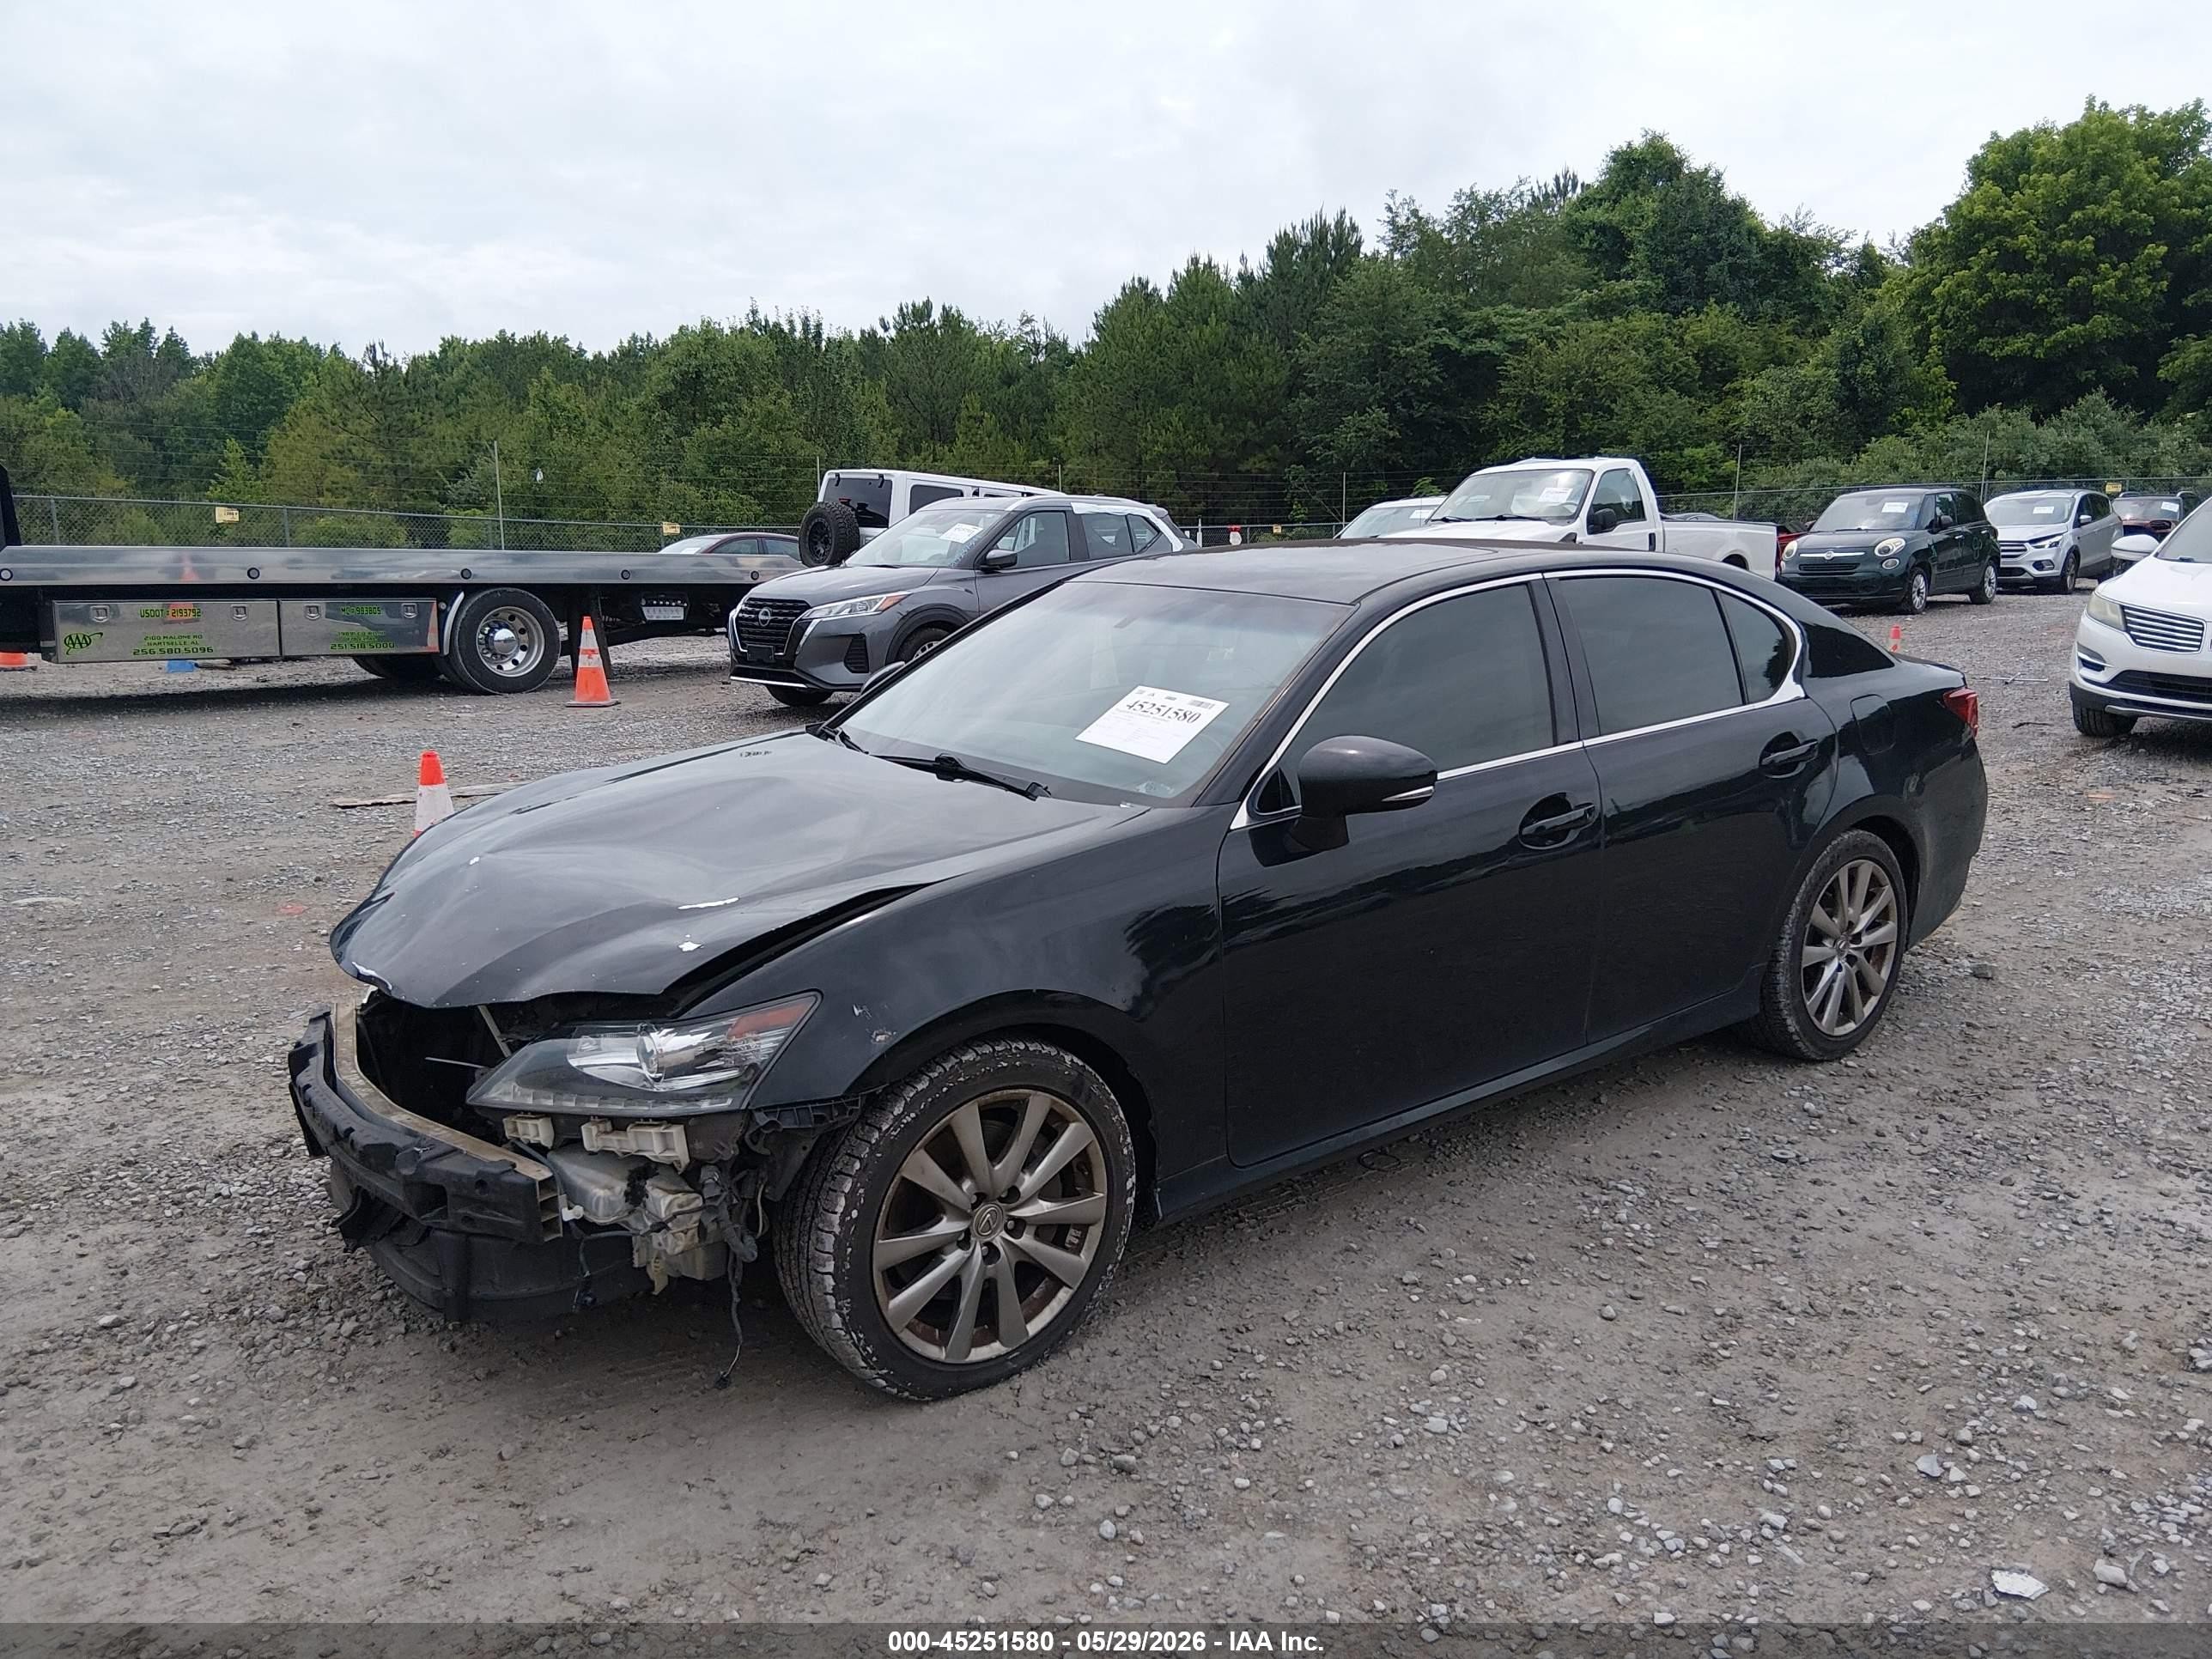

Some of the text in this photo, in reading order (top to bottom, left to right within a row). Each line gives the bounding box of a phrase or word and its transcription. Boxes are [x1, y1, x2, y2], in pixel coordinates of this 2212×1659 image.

[140, 608, 165, 618] USDOT
[172, 608, 201, 617] 2193792
[1126, 699, 1202, 724] 45251580
